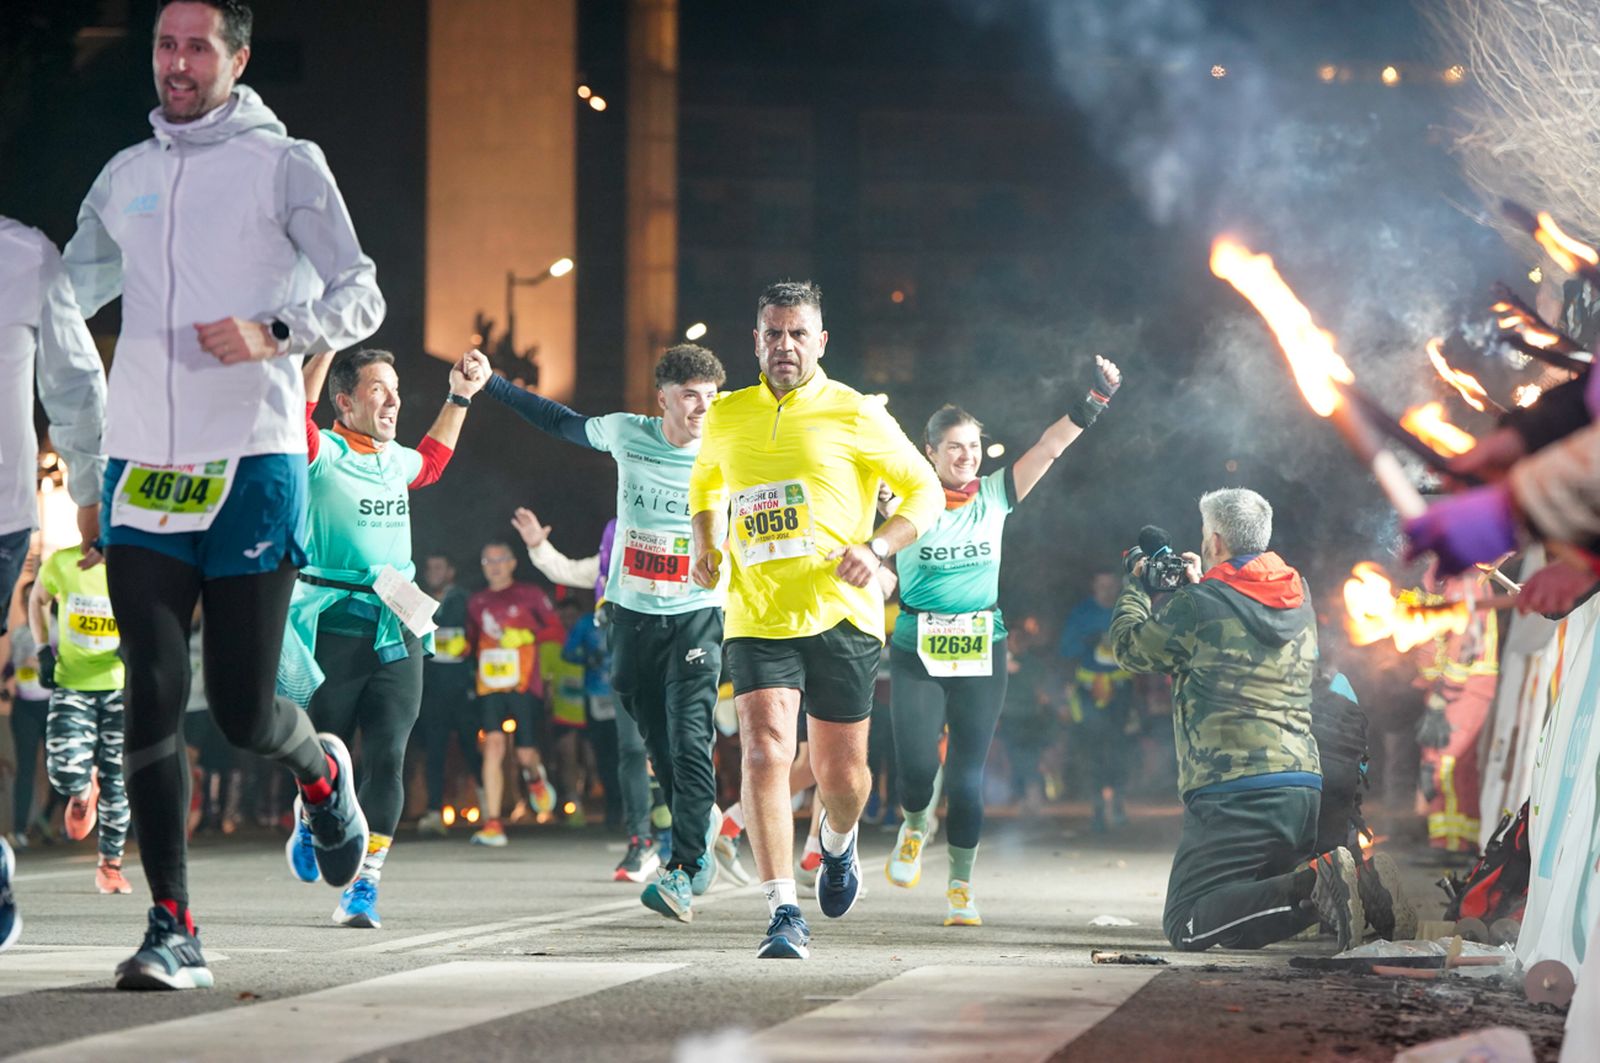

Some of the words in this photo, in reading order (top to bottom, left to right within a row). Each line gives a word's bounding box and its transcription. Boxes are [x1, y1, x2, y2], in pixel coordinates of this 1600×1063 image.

[138, 472, 210, 505] 4604
[768, 489, 778, 500] DE
[359, 494, 410, 516] será
[744, 507, 799, 537] 9058
[919, 540, 991, 560] serás
[634, 550, 679, 575] 9769
[79, 615, 117, 632] 2570
[928, 635, 983, 655] 12634
